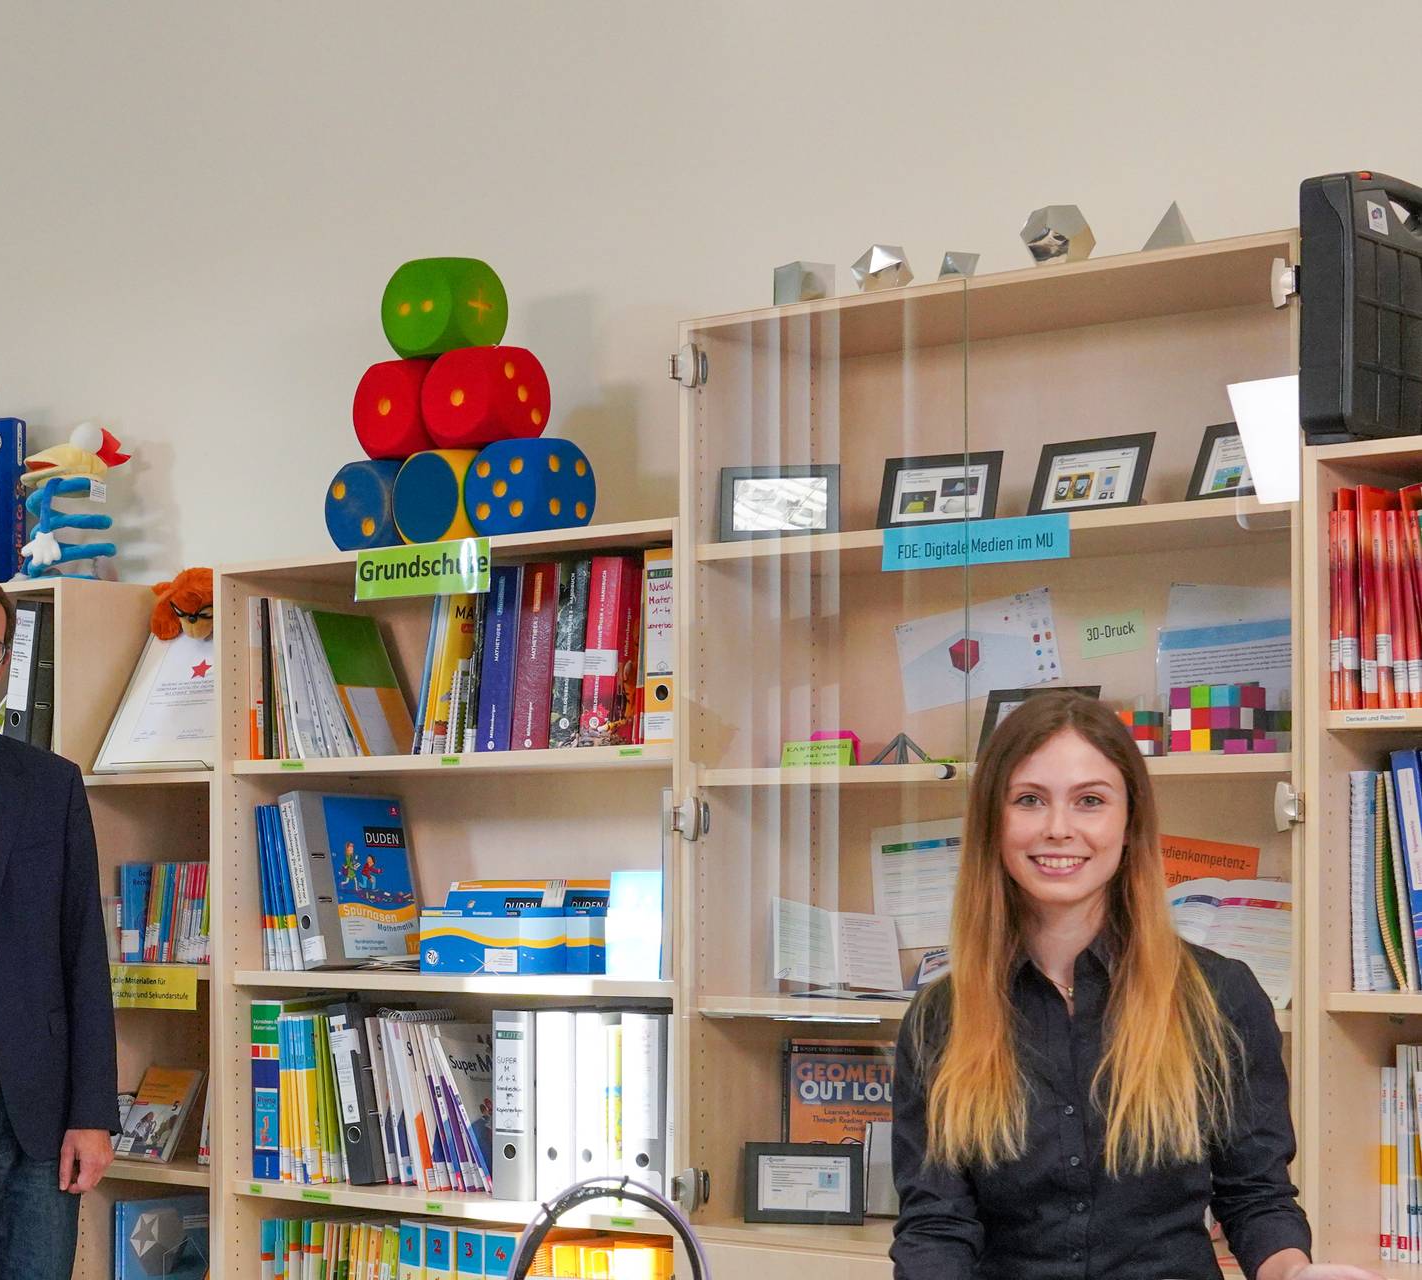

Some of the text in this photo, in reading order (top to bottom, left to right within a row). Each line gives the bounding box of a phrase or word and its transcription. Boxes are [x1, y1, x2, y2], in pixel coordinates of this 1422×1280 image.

[897, 532, 1054, 560] FDE: Digitale Medien im MU
[1086, 621, 1136, 641] 3D-Druck
[365, 832, 399, 844] DUDEN
[1161, 846, 1250, 870] edienkompetenz-
[377, 923, 414, 932] Mathematik
[449, 1055, 477, 1075] Super
[796, 1062, 891, 1083] GEOMET
[800, 1080, 892, 1102] OUT LOU
[171, 1100, 180, 1111] 5
[406, 1238, 413, 1252] 1
[433, 1238, 442, 1254] 2
[464, 1242, 473, 1257] 3
[495, 1246, 506, 1260] 4
